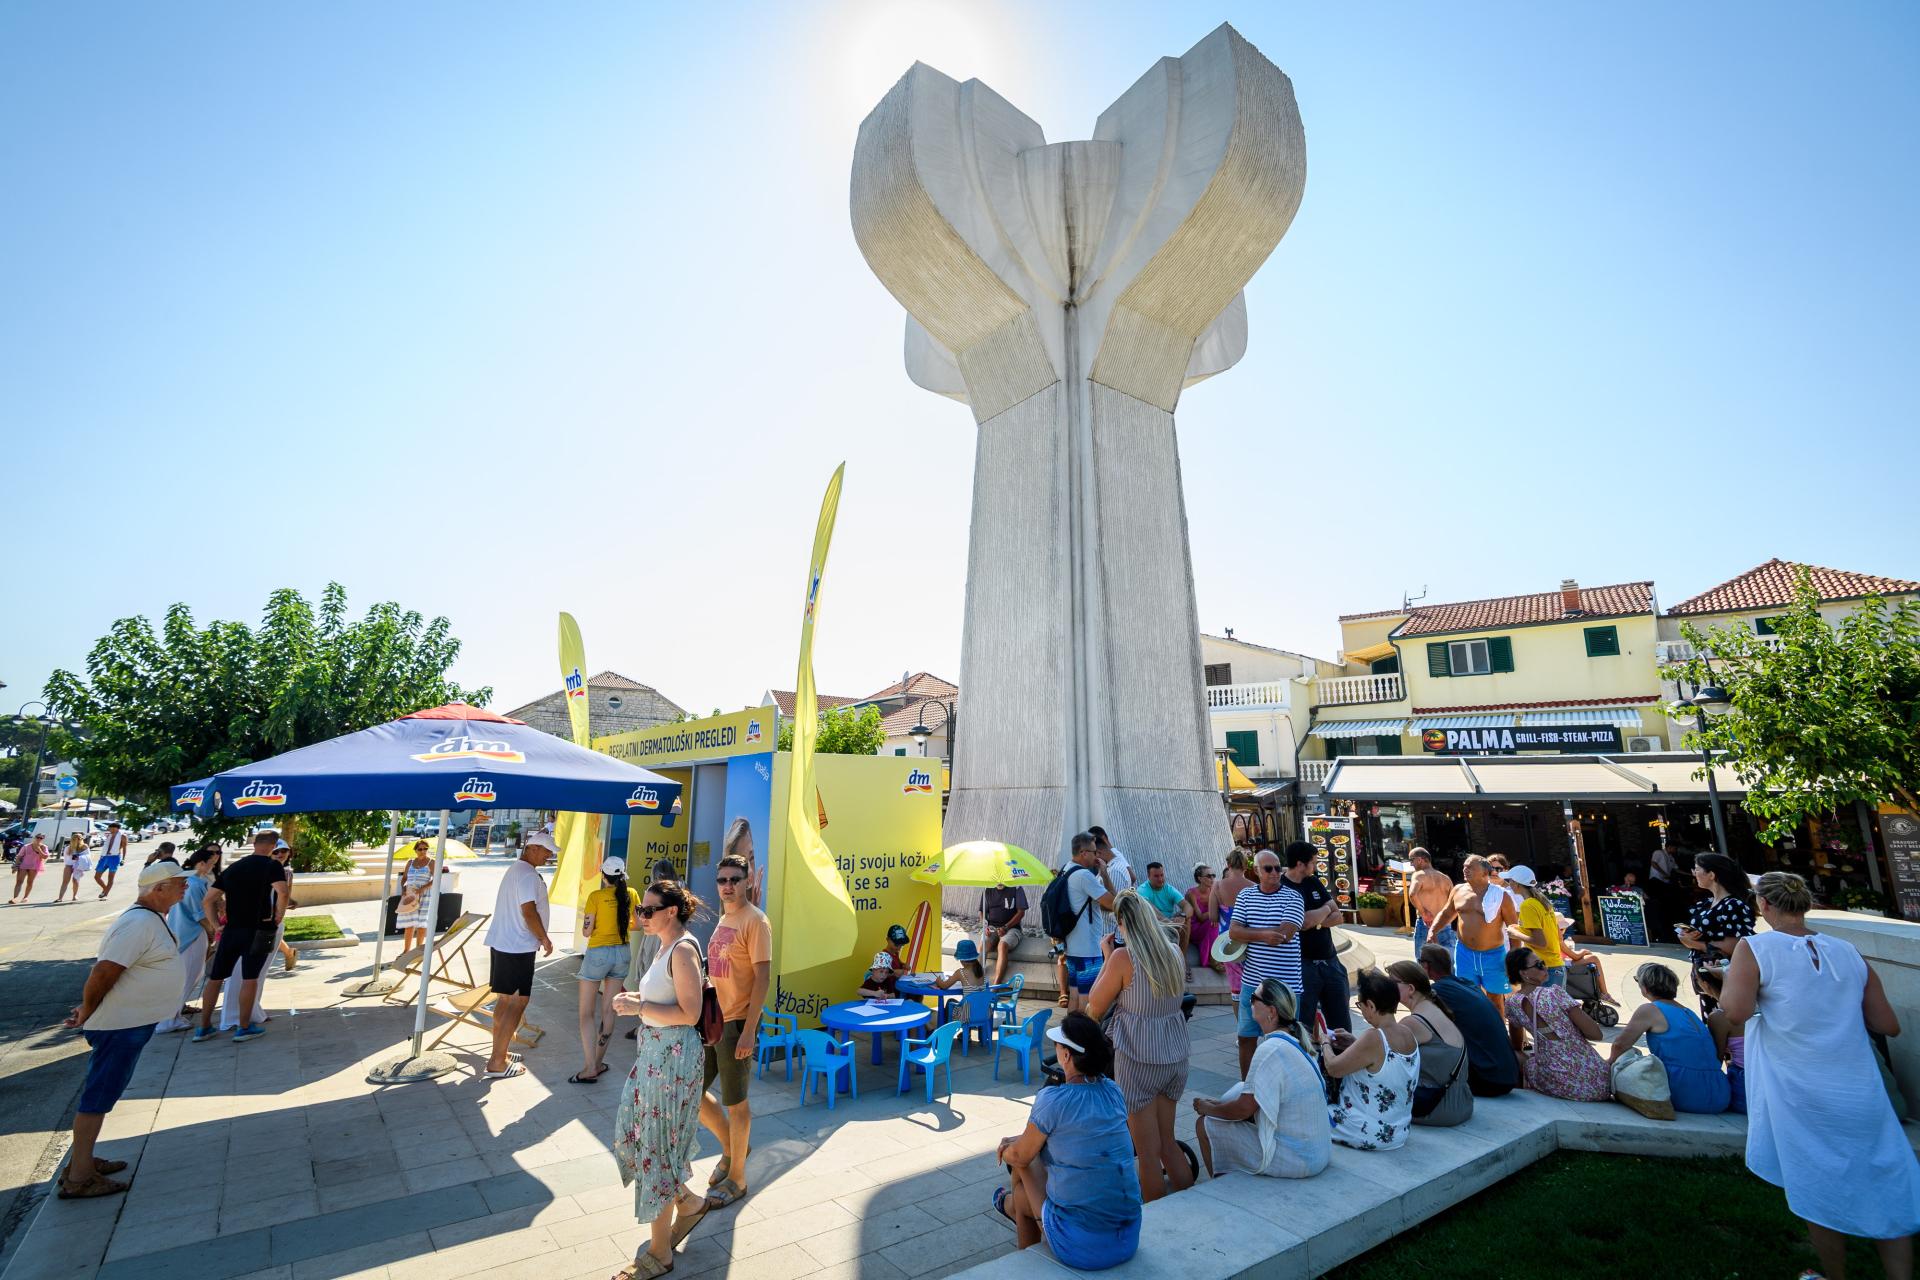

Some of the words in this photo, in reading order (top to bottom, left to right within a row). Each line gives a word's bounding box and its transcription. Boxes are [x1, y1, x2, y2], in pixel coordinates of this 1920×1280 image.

[430, 736, 511, 752] dm
[639, 730, 693, 756] DERMATOLOŠKI
[694, 726, 737, 750] PREGLEDI
[1446, 730, 1515, 749] PALMA
[909, 770, 930, 785] dm
[243, 781, 281, 797] dm
[463, 778, 493, 793] dm
[633, 786, 658, 800] dm
[646, 841, 670, 857] Moj
[860, 853, 895, 872] svoju
[855, 878, 870, 890] se
[875, 877, 889, 888] sa
[1604, 898, 1635, 909] Welcome
[1606, 914, 1629, 922] PIZZA
[1608, 927, 1632, 935] PASTA
